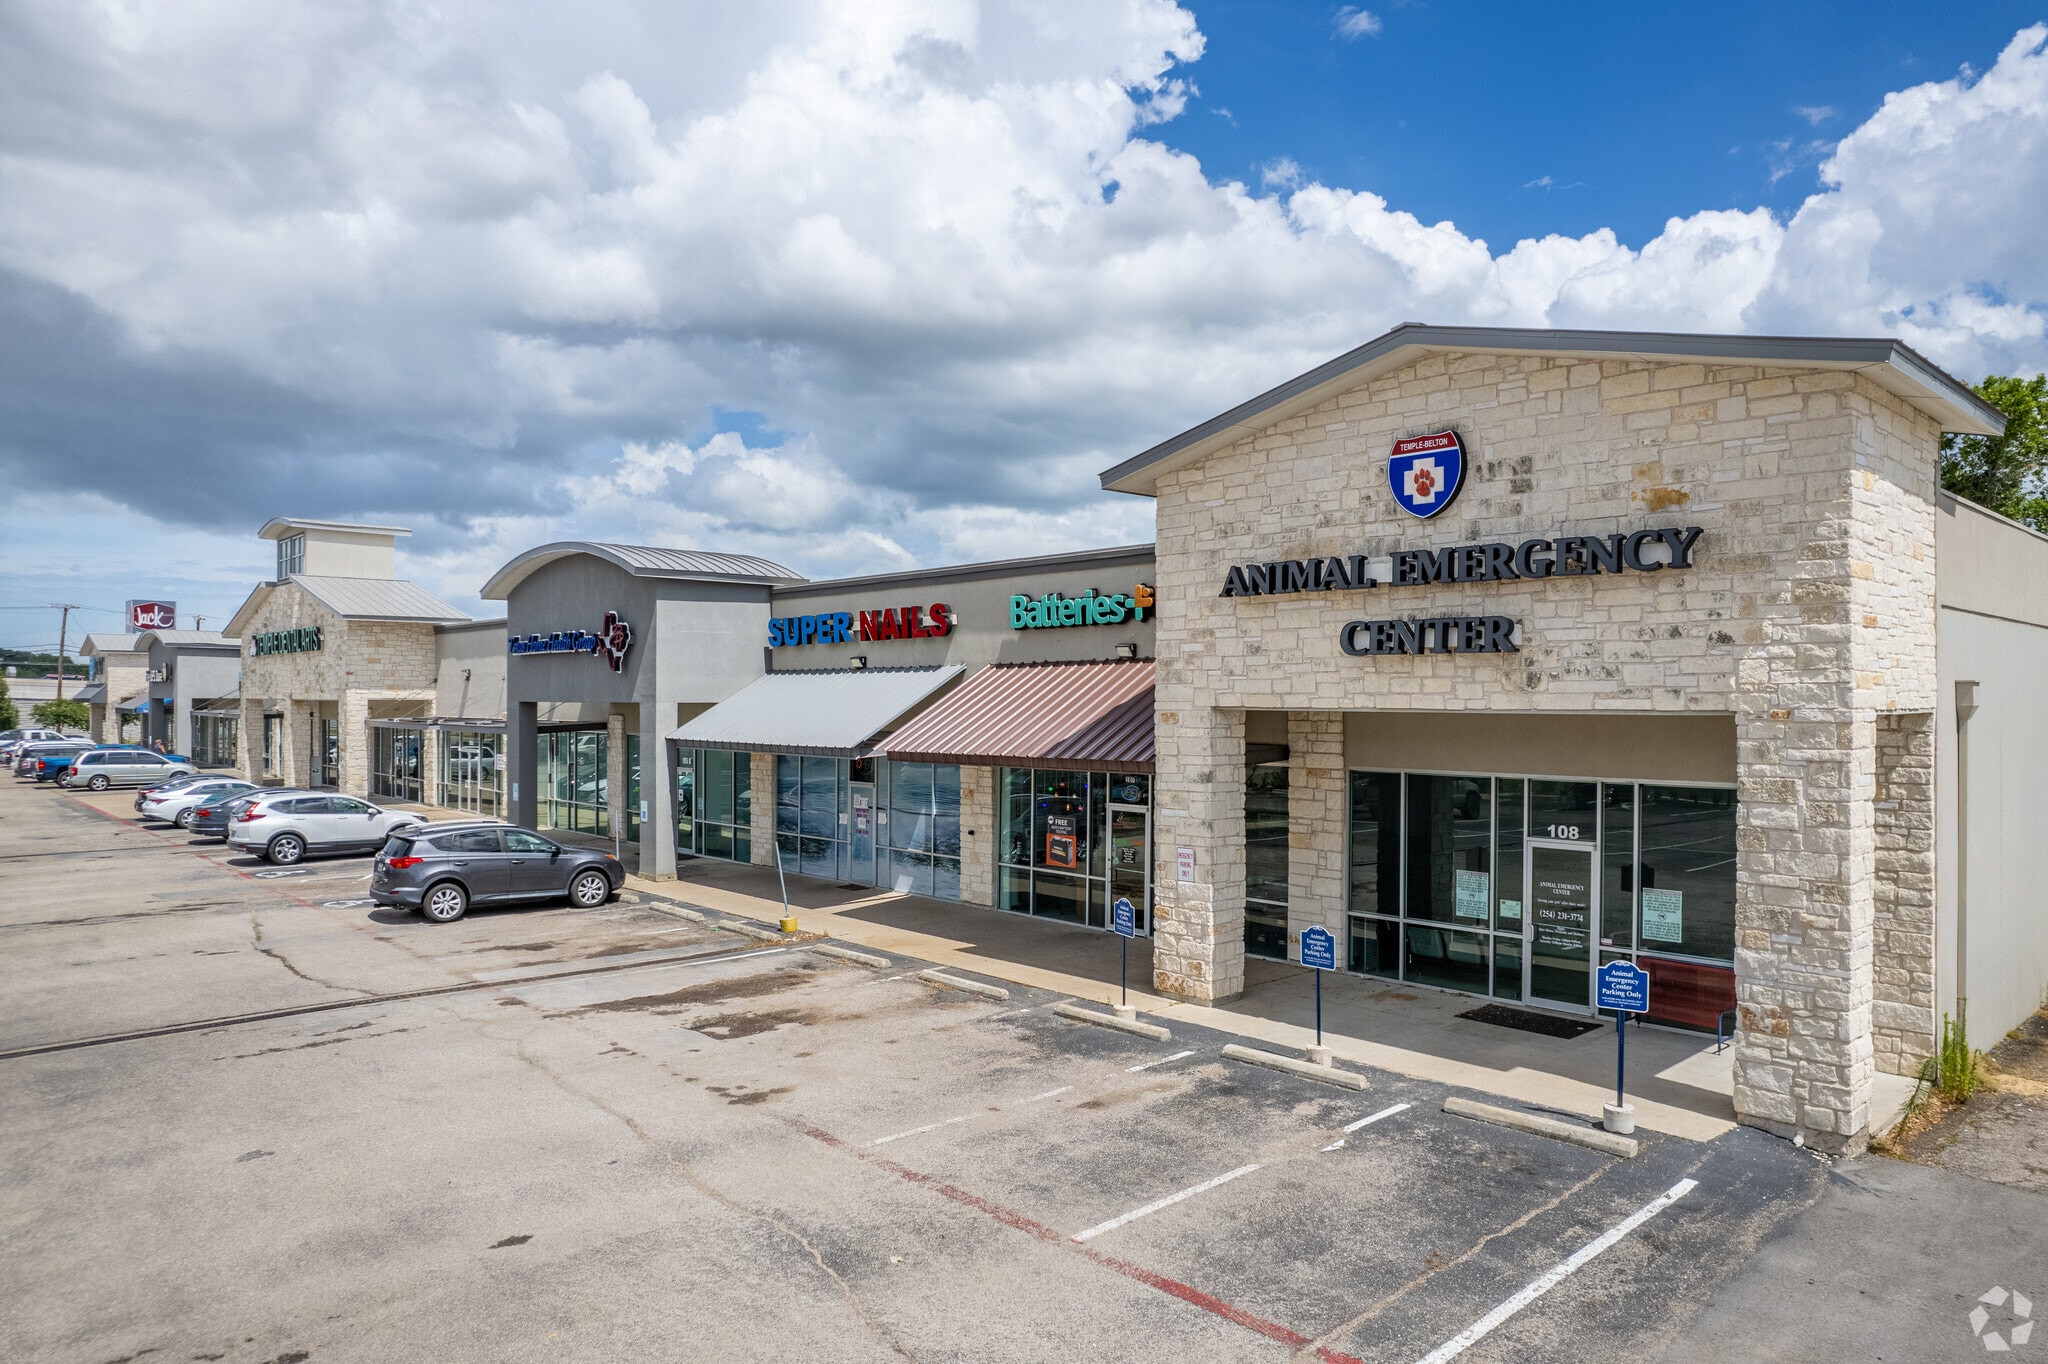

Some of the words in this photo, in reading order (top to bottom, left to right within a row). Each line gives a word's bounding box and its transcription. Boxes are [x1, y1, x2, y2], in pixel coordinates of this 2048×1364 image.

[1400, 438, 1448, 451] TEMPLE-BELTON
[1219, 555, 1377, 597] ANIMAL
[1389, 527, 1704, 587] EMERGENCY
[134, 605, 174, 628] Jack
[768, 611, 852, 648] SUPER
[859, 602, 950, 642] NAILS
[301, 626, 319, 652] ARTS
[1340, 615, 1520, 656] CENTER
[508, 636, 527, 654] Texas
[527, 634, 548, 653] Home
[572, 630, 597, 655] Group
[1054, 818, 1068, 826] FREE
[1547, 824, 1579, 840] 108
[1557, 883, 1584, 891] EMERGENCY
[1540, 909, 1556, 919] (254)
[1307, 938, 1328, 947] Emergency
[1305, 949, 1320, 957] Parking
[1320, 951, 1331, 959] Only
[1611, 969, 1634, 978] Animal
[1605, 975, 1639, 986] Emergency
[1611, 982, 1633, 991] Center
[1602, 988, 1626, 998] Parking
[1626, 990, 1642, 1000] Only
